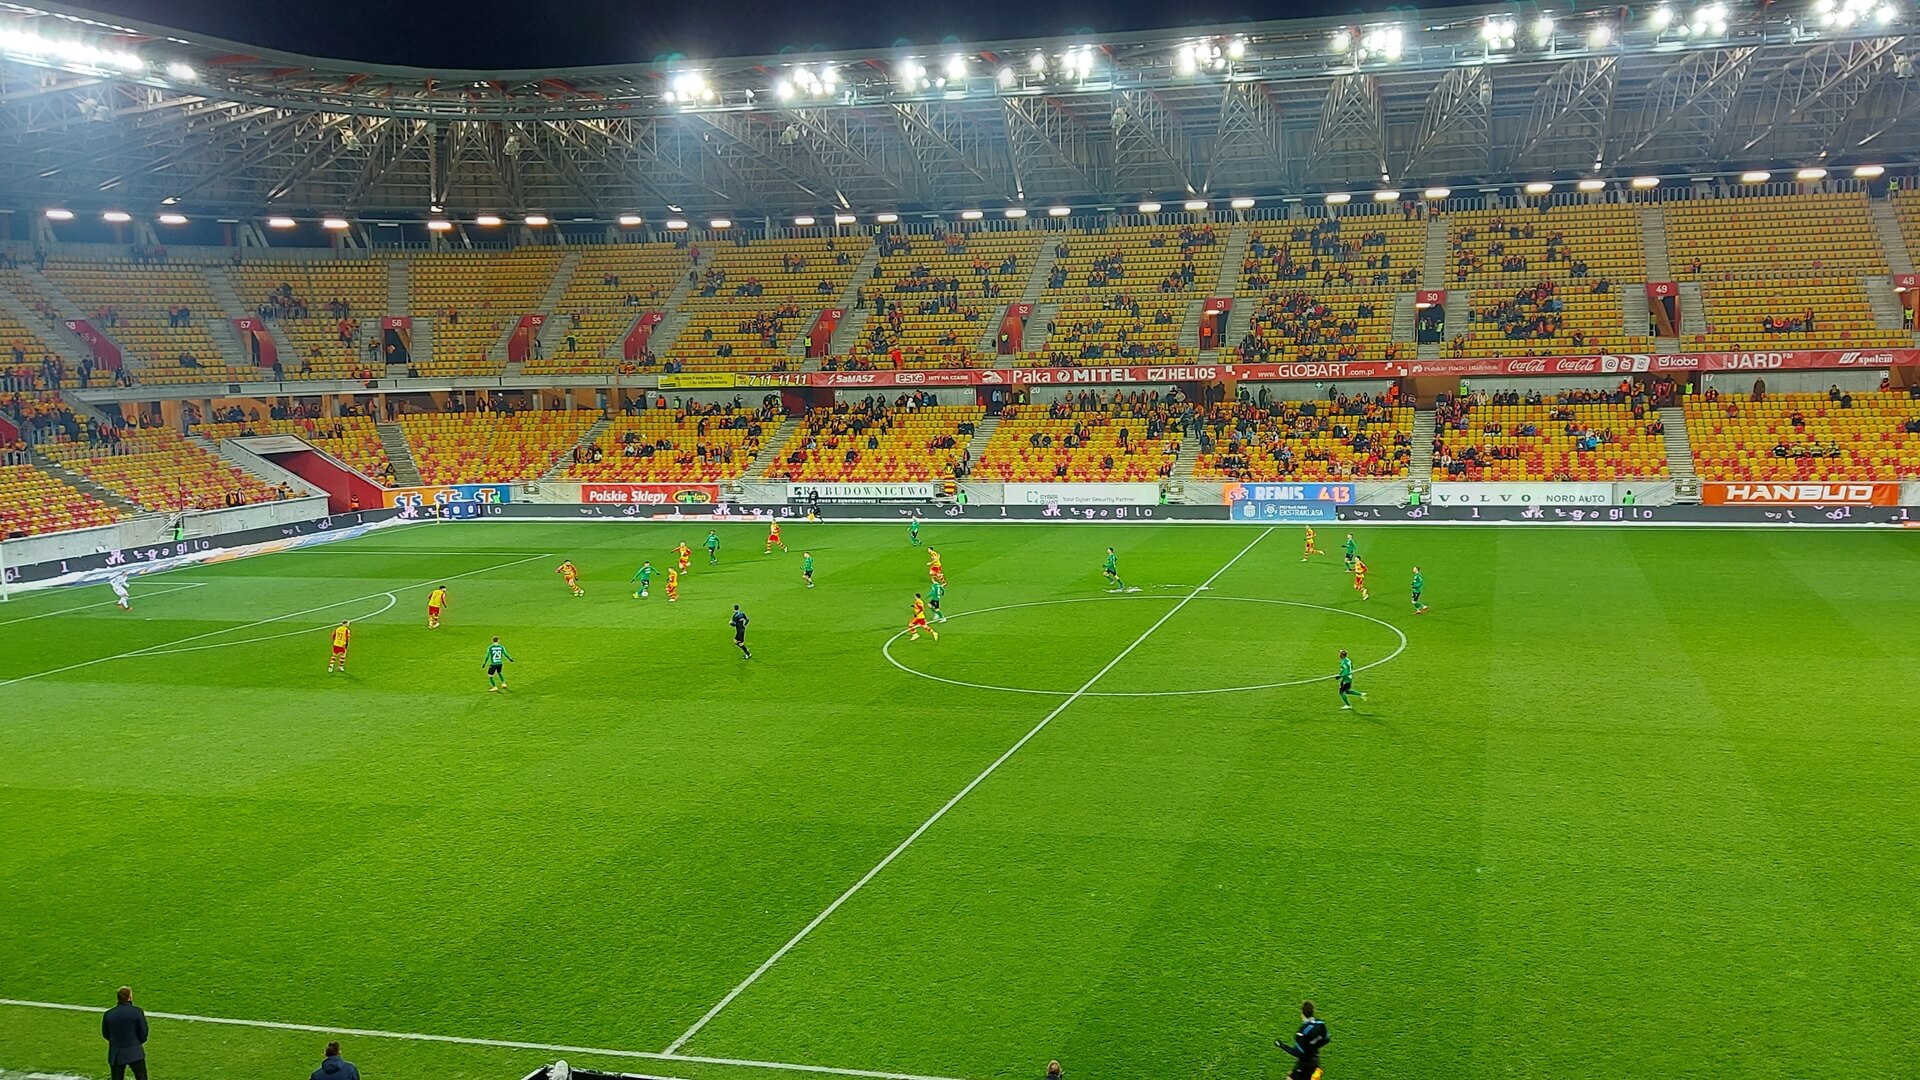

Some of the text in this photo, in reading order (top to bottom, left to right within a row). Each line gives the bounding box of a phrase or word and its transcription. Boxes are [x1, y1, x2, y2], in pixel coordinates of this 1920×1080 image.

[1902, 276, 1914, 285] 48
[1656, 284, 1668, 293] 49
[1427, 292, 1438, 300] 50
[832, 310, 840, 318] 53
[1018, 306, 1028, 314] 52
[1670, 356, 1698, 366] koba
[1728, 354, 1782, 368] JARD
[836, 374, 876, 382] SaMASZ
[1013, 370, 1050, 383] Paka
[1073, 368, 1137, 382] MITEL
[1168, 368, 1216, 380] HELIOS
[750, 375, 756, 386] 7
[825, 487, 927, 496] BUDOWNICTWO
[1255, 486, 1304, 500] REMIS
[1726, 485, 1874, 500] HANBUD
[395, 492, 422, 507] STS
[589, 490, 668, 505] Polskie Sklepy
[1439, 494, 1532, 502] VOLVO
[1546, 494, 1606, 502] NORD AUTO
[492, 650, 502, 660] 29
